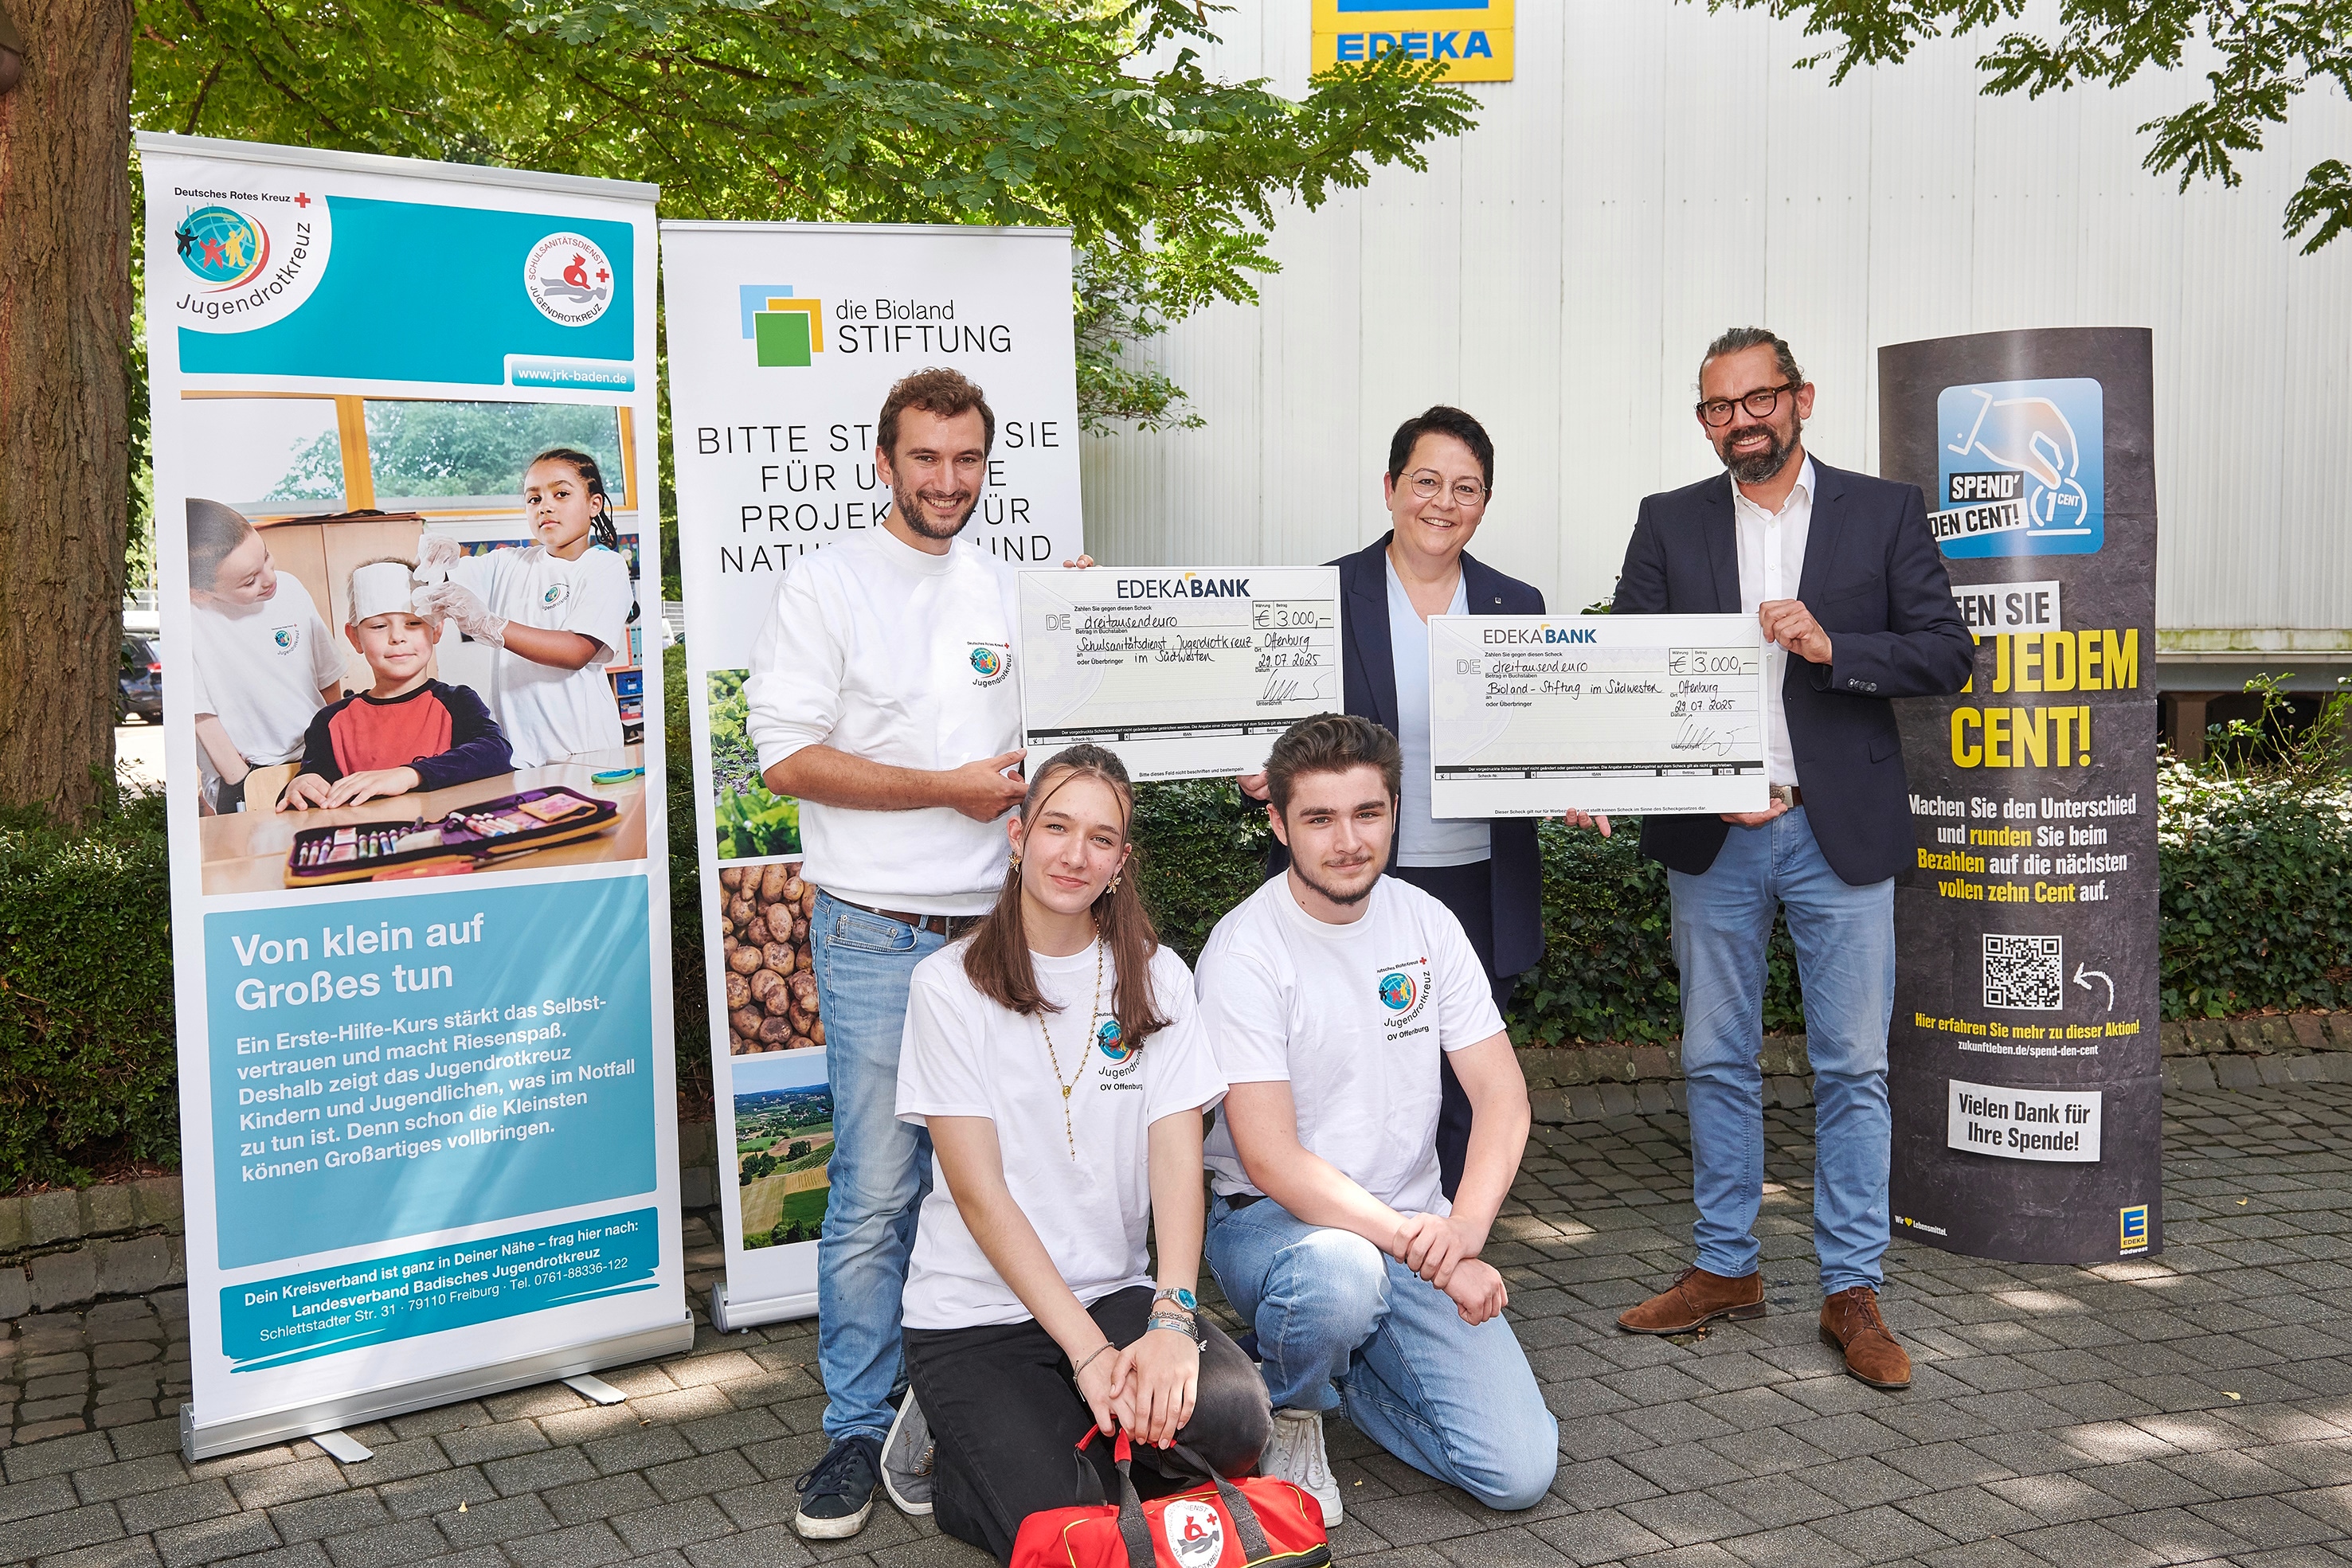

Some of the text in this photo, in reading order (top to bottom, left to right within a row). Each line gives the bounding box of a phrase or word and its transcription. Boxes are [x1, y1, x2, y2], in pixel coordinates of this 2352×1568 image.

[1337, 31, 1493, 61] EDEKA
[174, 187, 291, 202] Deutsches Rotes Kreuz
[177, 221, 311, 320] Jugendrotkreuz
[529, 237, 604, 280] SCHULSANITÄTSDIENST
[530, 286, 602, 323] JUGENDROTKREUZ
[836, 299, 954, 320] die Bioland
[838, 324, 1012, 354] STIFTUNG
[518, 369, 627, 384] www.jrk-baden.de
[698, 425, 808, 455] BITTE
[1004, 421, 1059, 448] SIE
[761, 459, 836, 493] FÜR
[742, 494, 1030, 532] PROJEK ÜR
[1928, 503, 2020, 538] DEN CENT!
[2045, 492, 2080, 522] 1 CENT
[1046, 614, 1071, 631] DE
[1254, 610, 1270, 627] €
[2006, 592, 2049, 625] SIE
[1134, 653, 1148, 663] im
[1265, 632, 1310, 653] Offenburg
[972, 654, 1012, 688] Jugendrotkreuz
[1457, 659, 1481, 675] DE
[1669, 656, 1686, 673] €
[1993, 628, 2138, 694] JEDEM
[1591, 685, 1601, 694] im
[1679, 680, 1718, 702] Offenburg
[1951, 706, 2091, 768] CENT!
[1908, 793, 2136, 819] Machen Sie den Unterschied
[1938, 824, 2107, 847] und runden Sie beim
[1917, 847, 2127, 874] Bezahlen auf die nächsten
[1938, 878, 2109, 902] vollen zehn Cent auf.
[231, 913, 484, 966] Von klein auf
[235, 964, 452, 1011] Großes tun
[1383, 971, 1430, 1028] Jugendrotkreuz
[237, 995, 606, 1055] Ein Erste-Hilfe-Kurs stärkt das Selbst-
[1399, 1026, 1429, 1038] Offenburg
[1915, 1012, 2140, 1039] Hier erfahren Sie mehr zu dieser Aktion!
[237, 1023, 566, 1080] vertrauen und macht Riesenspaß.
[1958, 1040, 2098, 1058] zukunftleben.de/spend-den-cent
[239, 1048, 572, 1105] Deshalb zeigt das Jugendrotkreuz
[240, 1058, 635, 1131] Kindern und Jugendlichen, was im Notfall
[1959, 1093, 2090, 1124] Vielen Dank für
[241, 1093, 587, 1157] zu tun ist. Denn schon die Kleinsten
[1968, 1121, 2079, 1152] Ihre Spende!
[242, 1121, 554, 1182] können Großartiges vollbringen.
[1895, 1215, 1947, 1236] Wir Lebensmittel.
[245, 1221, 638, 1307] Dein Kreisverband ist ganz in Deiner Nähe frag hier nach:
[2119, 1246, 2148, 1255] Südwest
[292, 1248, 601, 1318] Landesverband Badisches Jugendrotkreuz
[260, 1257, 628, 1341] Schlettstadter Str. 31 79110 Freiburg Tel. 0761-88336-122
